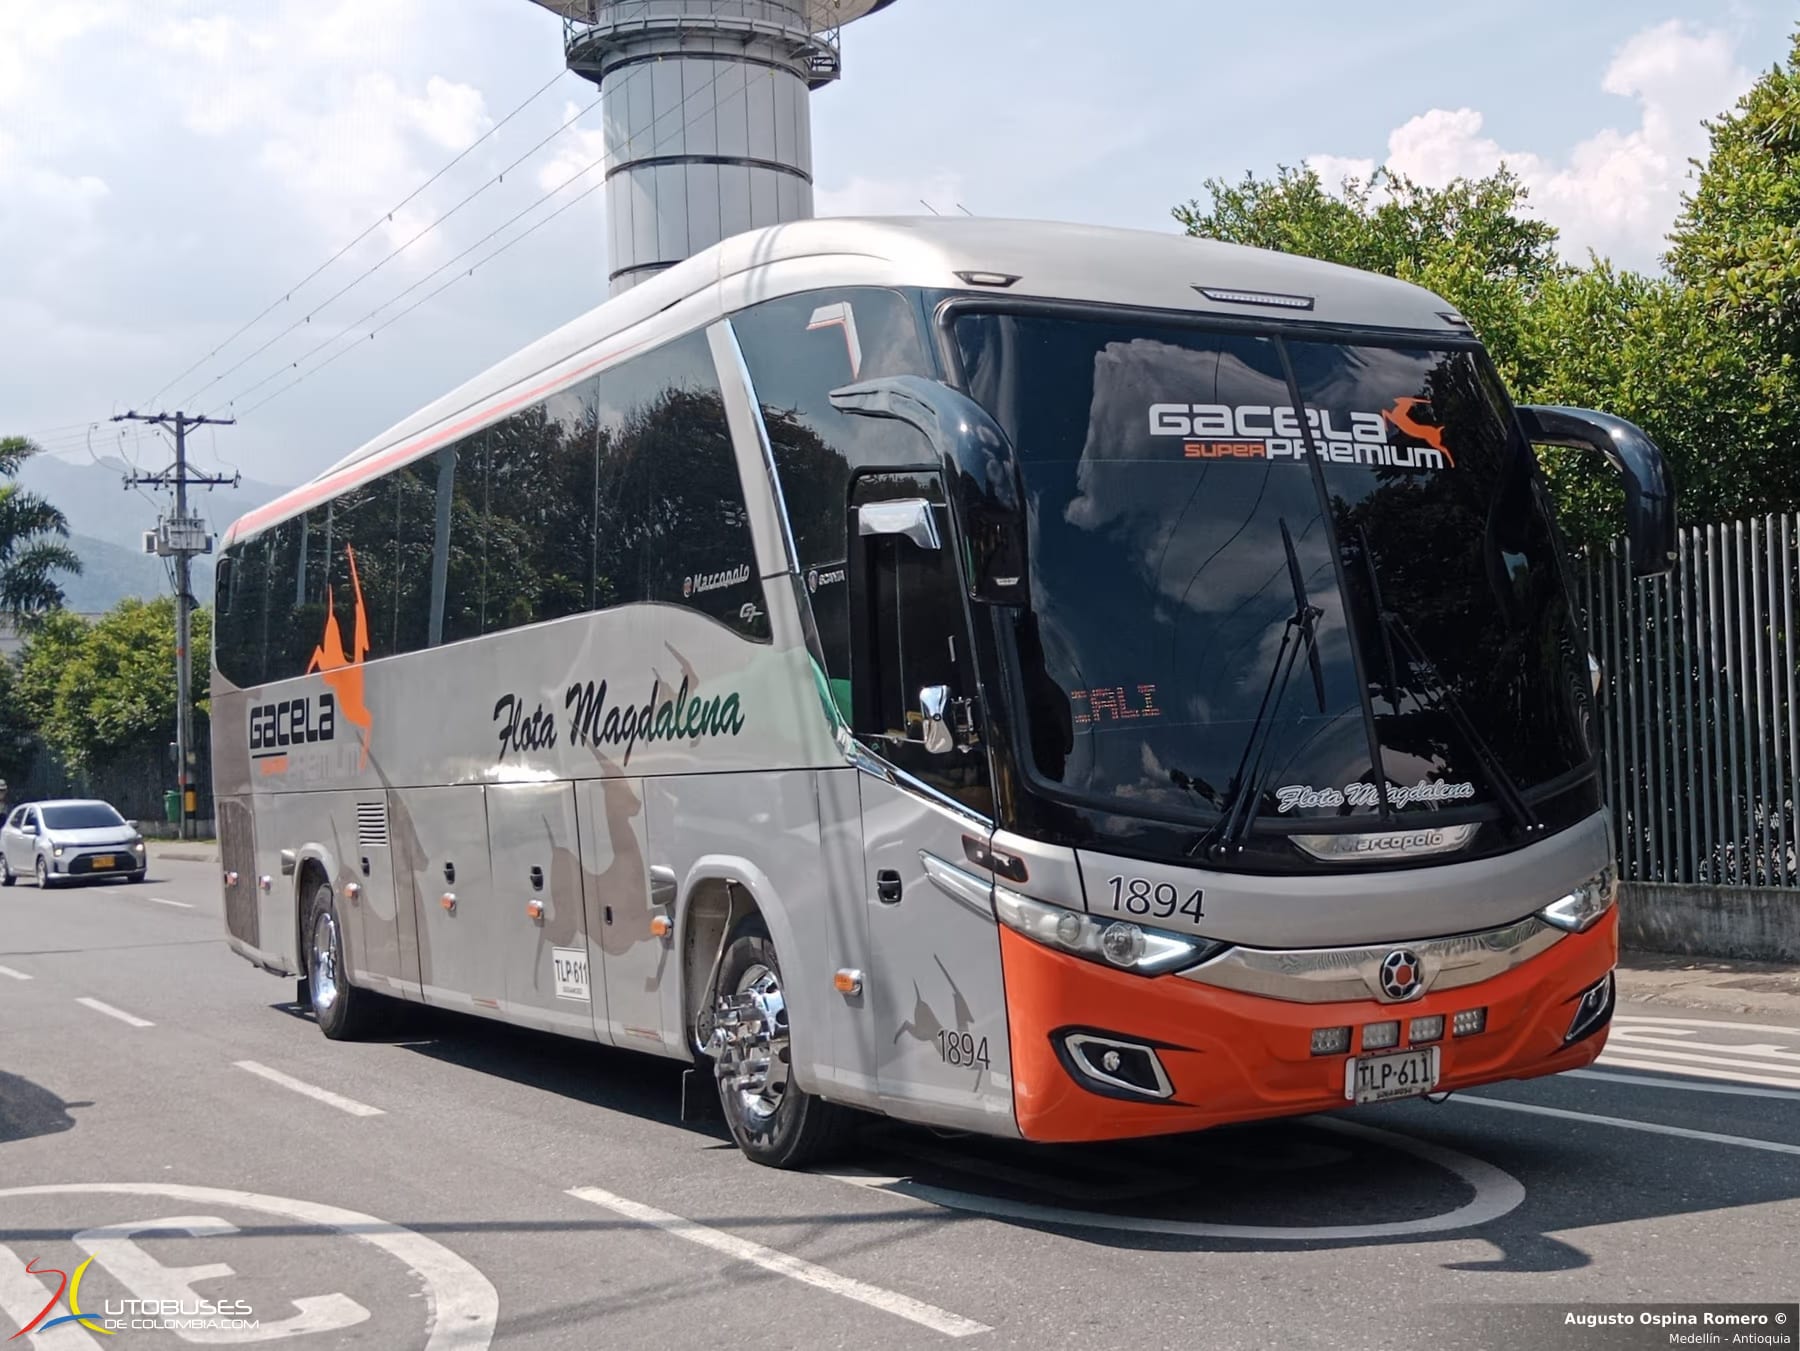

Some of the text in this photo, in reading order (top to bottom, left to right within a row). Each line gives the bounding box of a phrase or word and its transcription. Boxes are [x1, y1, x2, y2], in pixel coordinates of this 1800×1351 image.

[493, 674, 746, 767] Flota Magdalena
[1276, 778, 1476, 813] Flota Magdalena
[1108, 874, 1206, 925] 1894
[936, 1029, 991, 1071] 1894
